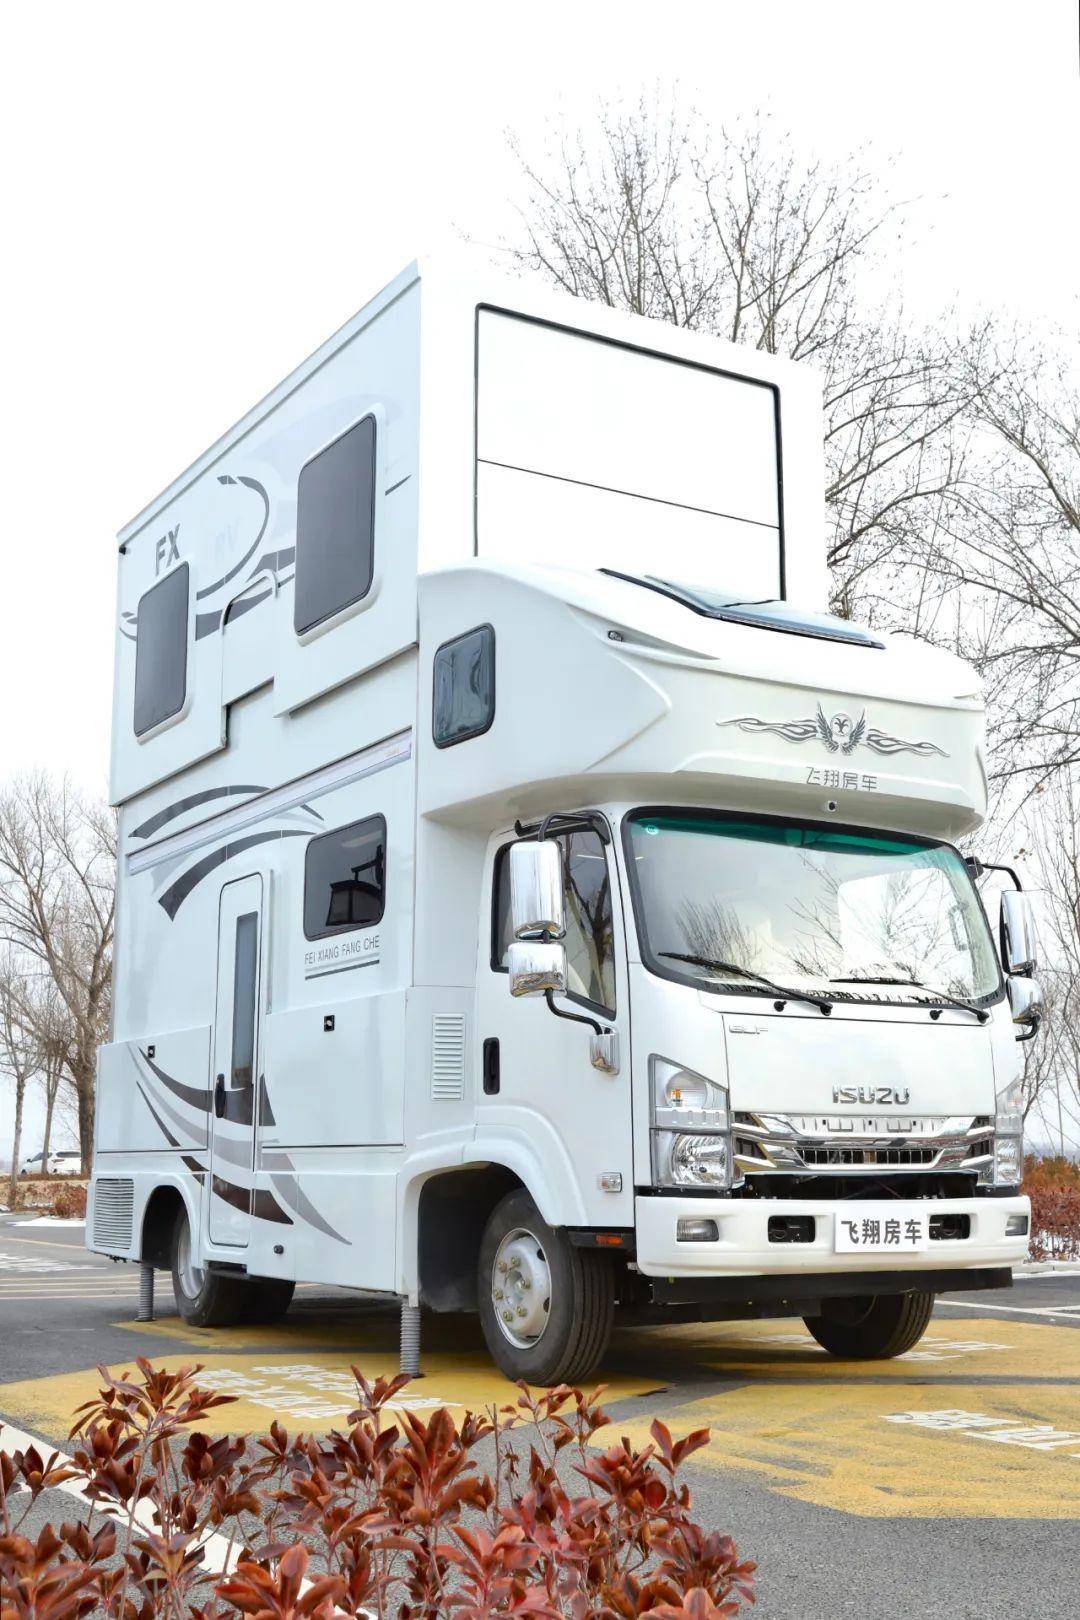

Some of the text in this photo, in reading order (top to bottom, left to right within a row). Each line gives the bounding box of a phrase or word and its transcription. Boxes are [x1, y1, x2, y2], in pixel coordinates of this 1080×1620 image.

[155, 523, 181, 577] FX
[806, 766, 877, 792] 飞翔房车
[305, 935, 380, 964] FEI XIANG FANG CHE
[832, 1084, 911, 1105] ISUZU
[841, 1218, 923, 1245] 飞翔房车
